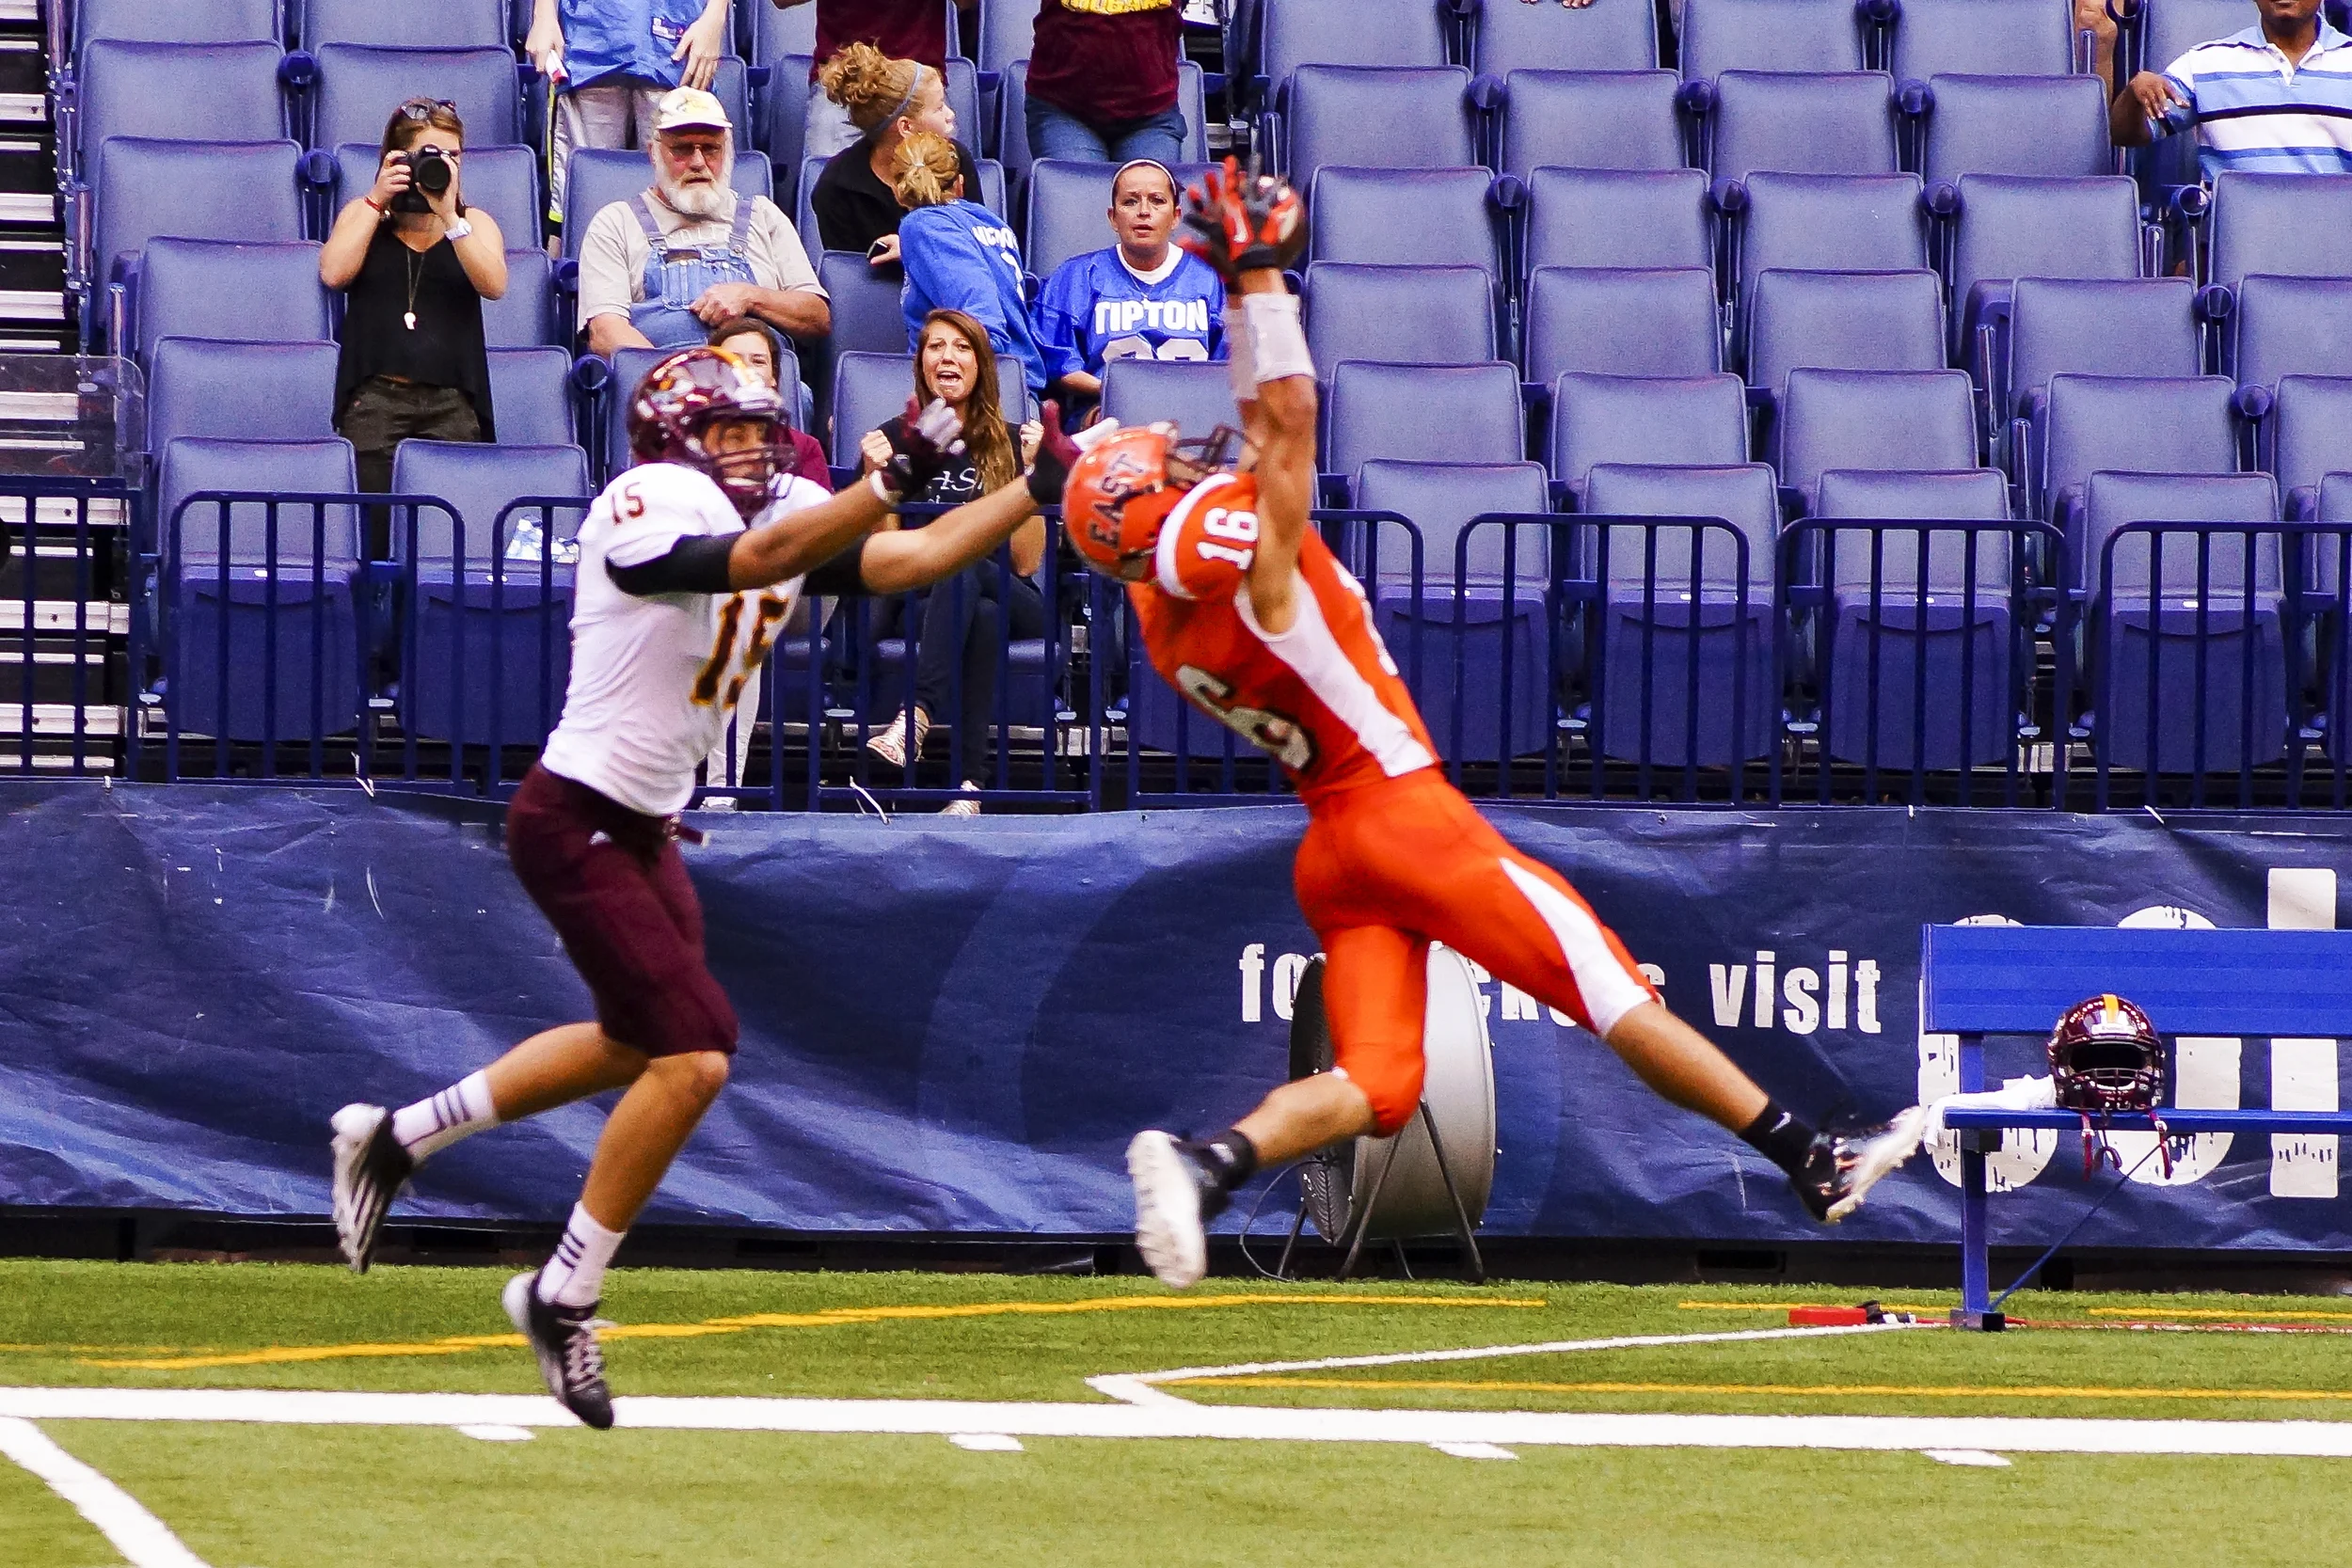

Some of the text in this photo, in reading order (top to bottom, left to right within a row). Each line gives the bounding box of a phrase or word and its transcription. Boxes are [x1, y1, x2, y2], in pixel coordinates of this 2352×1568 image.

[1094, 298, 1209, 335] TIPTON
[612, 481, 645, 525] 15
[1089, 452, 1144, 550] EAST
[1195, 507, 1260, 571] 16
[1239, 943, 1327, 1022] fo
[1708, 949, 1882, 1036] visit
